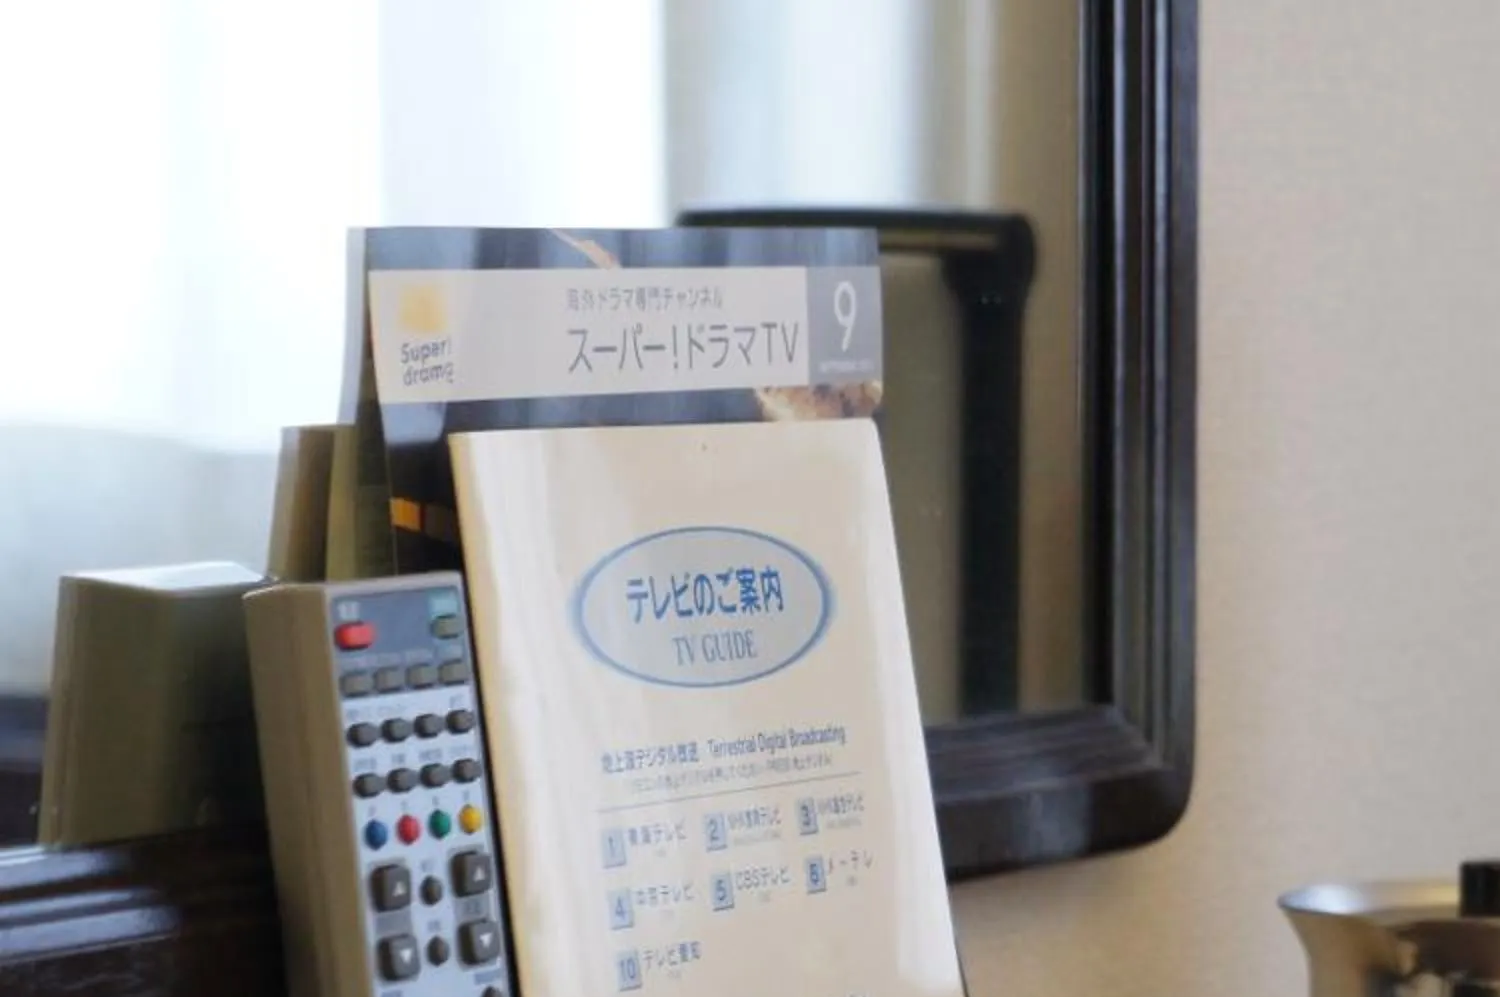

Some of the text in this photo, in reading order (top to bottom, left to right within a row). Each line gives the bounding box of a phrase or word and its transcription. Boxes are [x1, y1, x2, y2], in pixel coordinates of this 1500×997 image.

[833, 281, 858, 352] 9
[625, 566, 785, 624] テレビのご案内
[671, 629, 758, 666] TV GUIDE
[789, 725, 846, 746] Broadcasting
